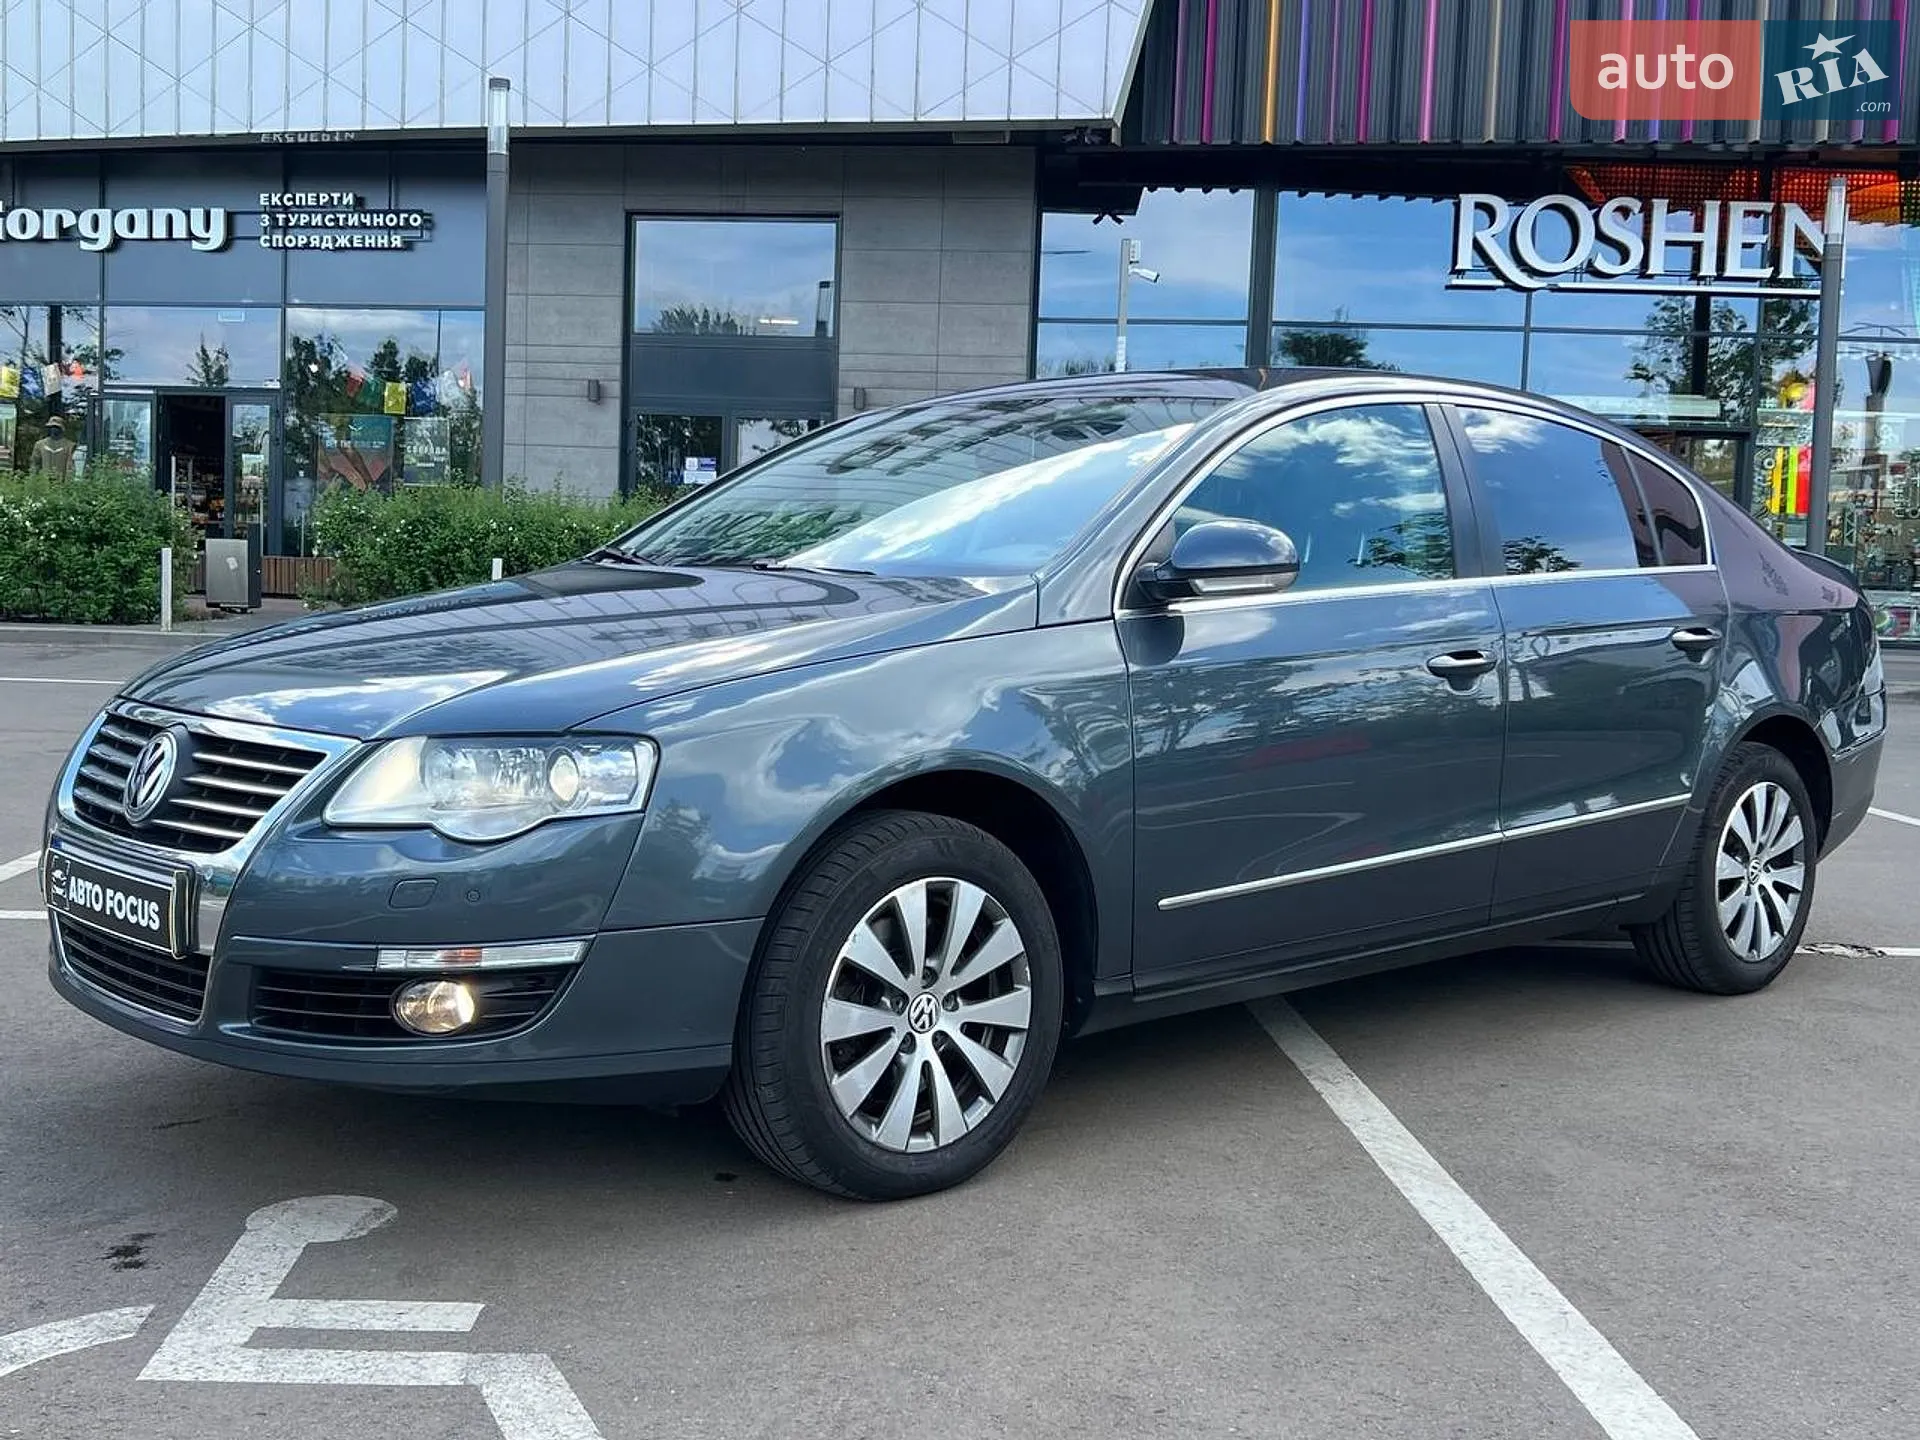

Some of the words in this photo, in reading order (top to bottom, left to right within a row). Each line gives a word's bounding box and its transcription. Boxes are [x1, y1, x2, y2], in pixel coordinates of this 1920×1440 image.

[259, 193, 354, 206] ЕКСПЕРТИ
[0, 200, 229, 251] organy
[276, 213, 422, 227] ТУРИСТИЧНОГО
[259, 235, 401, 249] СПОРЯДЖЕННЯ
[106, 888, 160, 931] FOCUS
